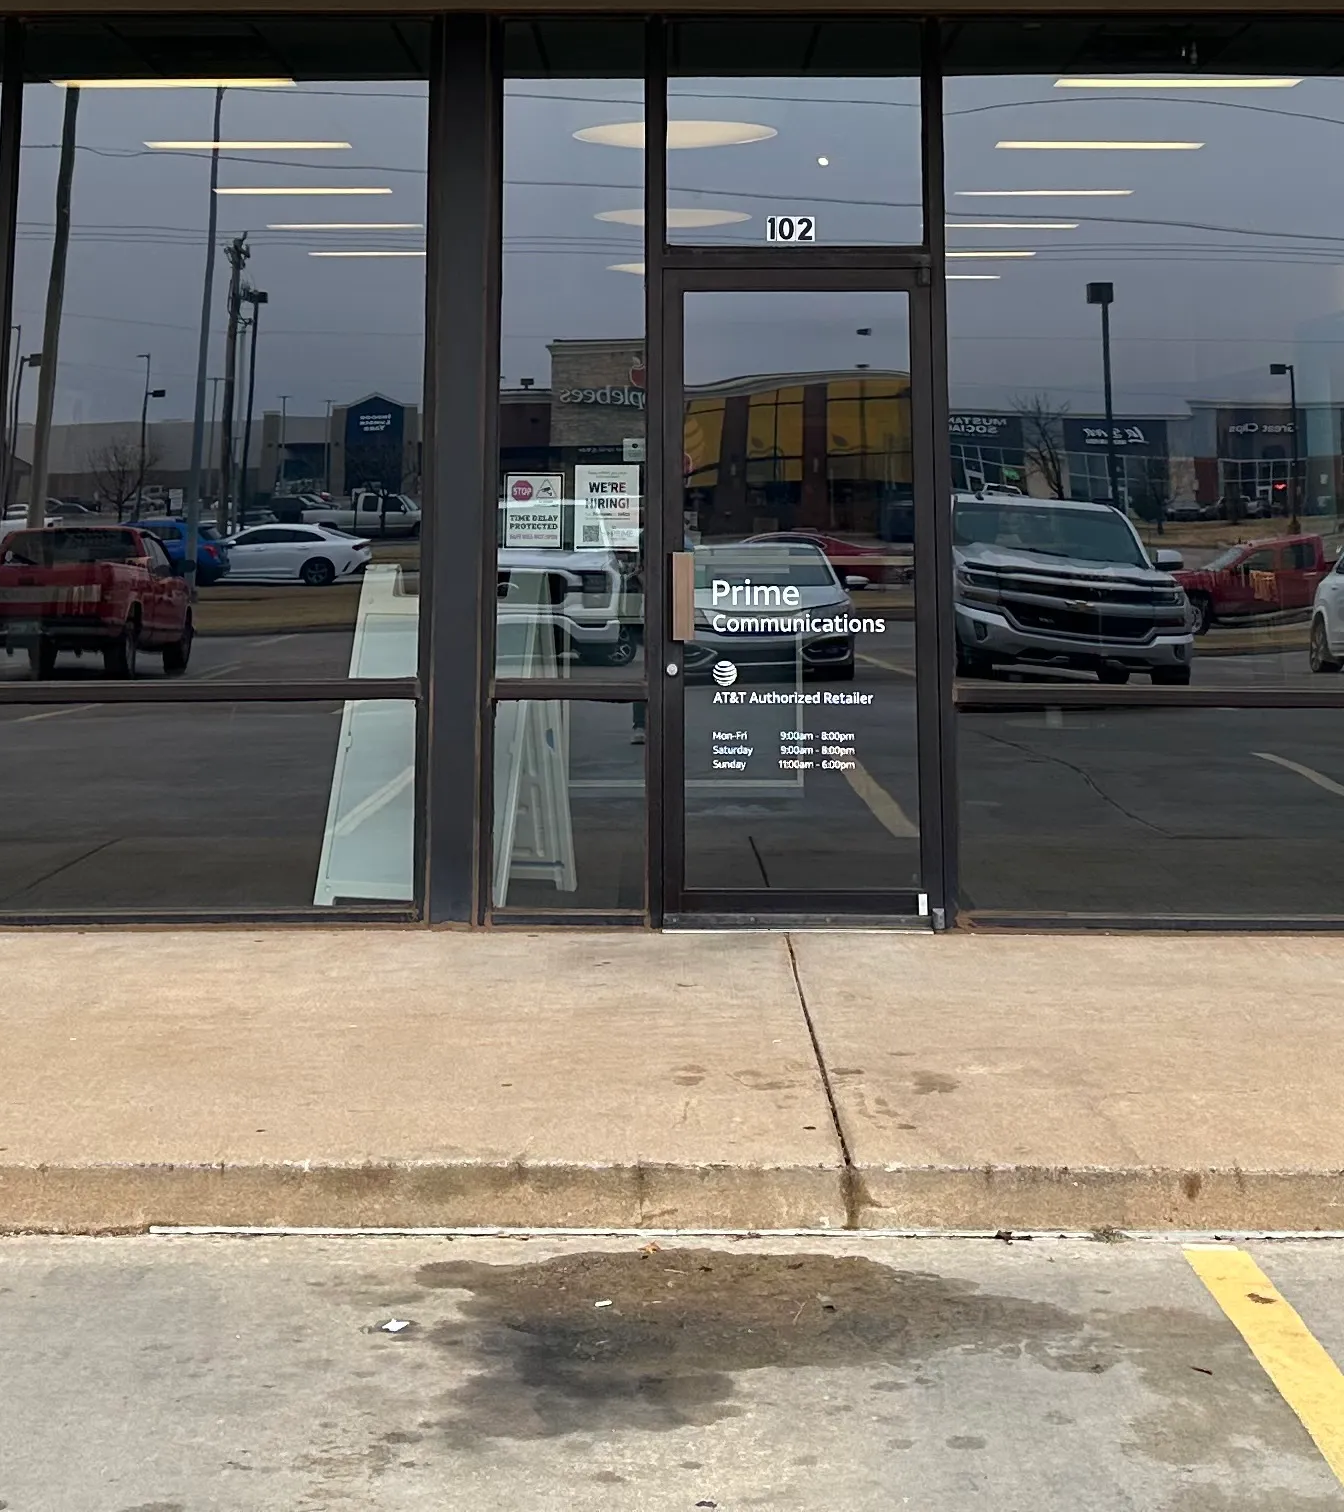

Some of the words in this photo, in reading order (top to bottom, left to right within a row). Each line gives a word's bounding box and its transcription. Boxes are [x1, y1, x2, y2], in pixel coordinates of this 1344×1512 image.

[767, 217, 813, 241] 102
[512, 486, 533, 496] STOP
[588, 481, 627, 493] WE'RE
[585, 498, 630, 509] HIRING!
[510, 522, 558, 530] PROTECTED
[712, 579, 800, 606] Prime
[712, 613, 886, 633] Communications
[713, 691, 747, 704] AT&T
[749, 691, 821, 704] Authorized
[823, 691, 874, 705] Retailer
[712, 731, 748, 740] Mon-Fri
[780, 731, 814, 740] 9:00am
[821, 731, 855, 742] 8:00pm
[712, 745, 754, 756] Saturday
[780, 746, 814, 755] 9:00am
[821, 746, 855, 757] 8:00pm
[712, 759, 747, 771] Sunday
[778, 760, 814, 769] 11:00am
[821, 760, 856, 771] 6:00pm
